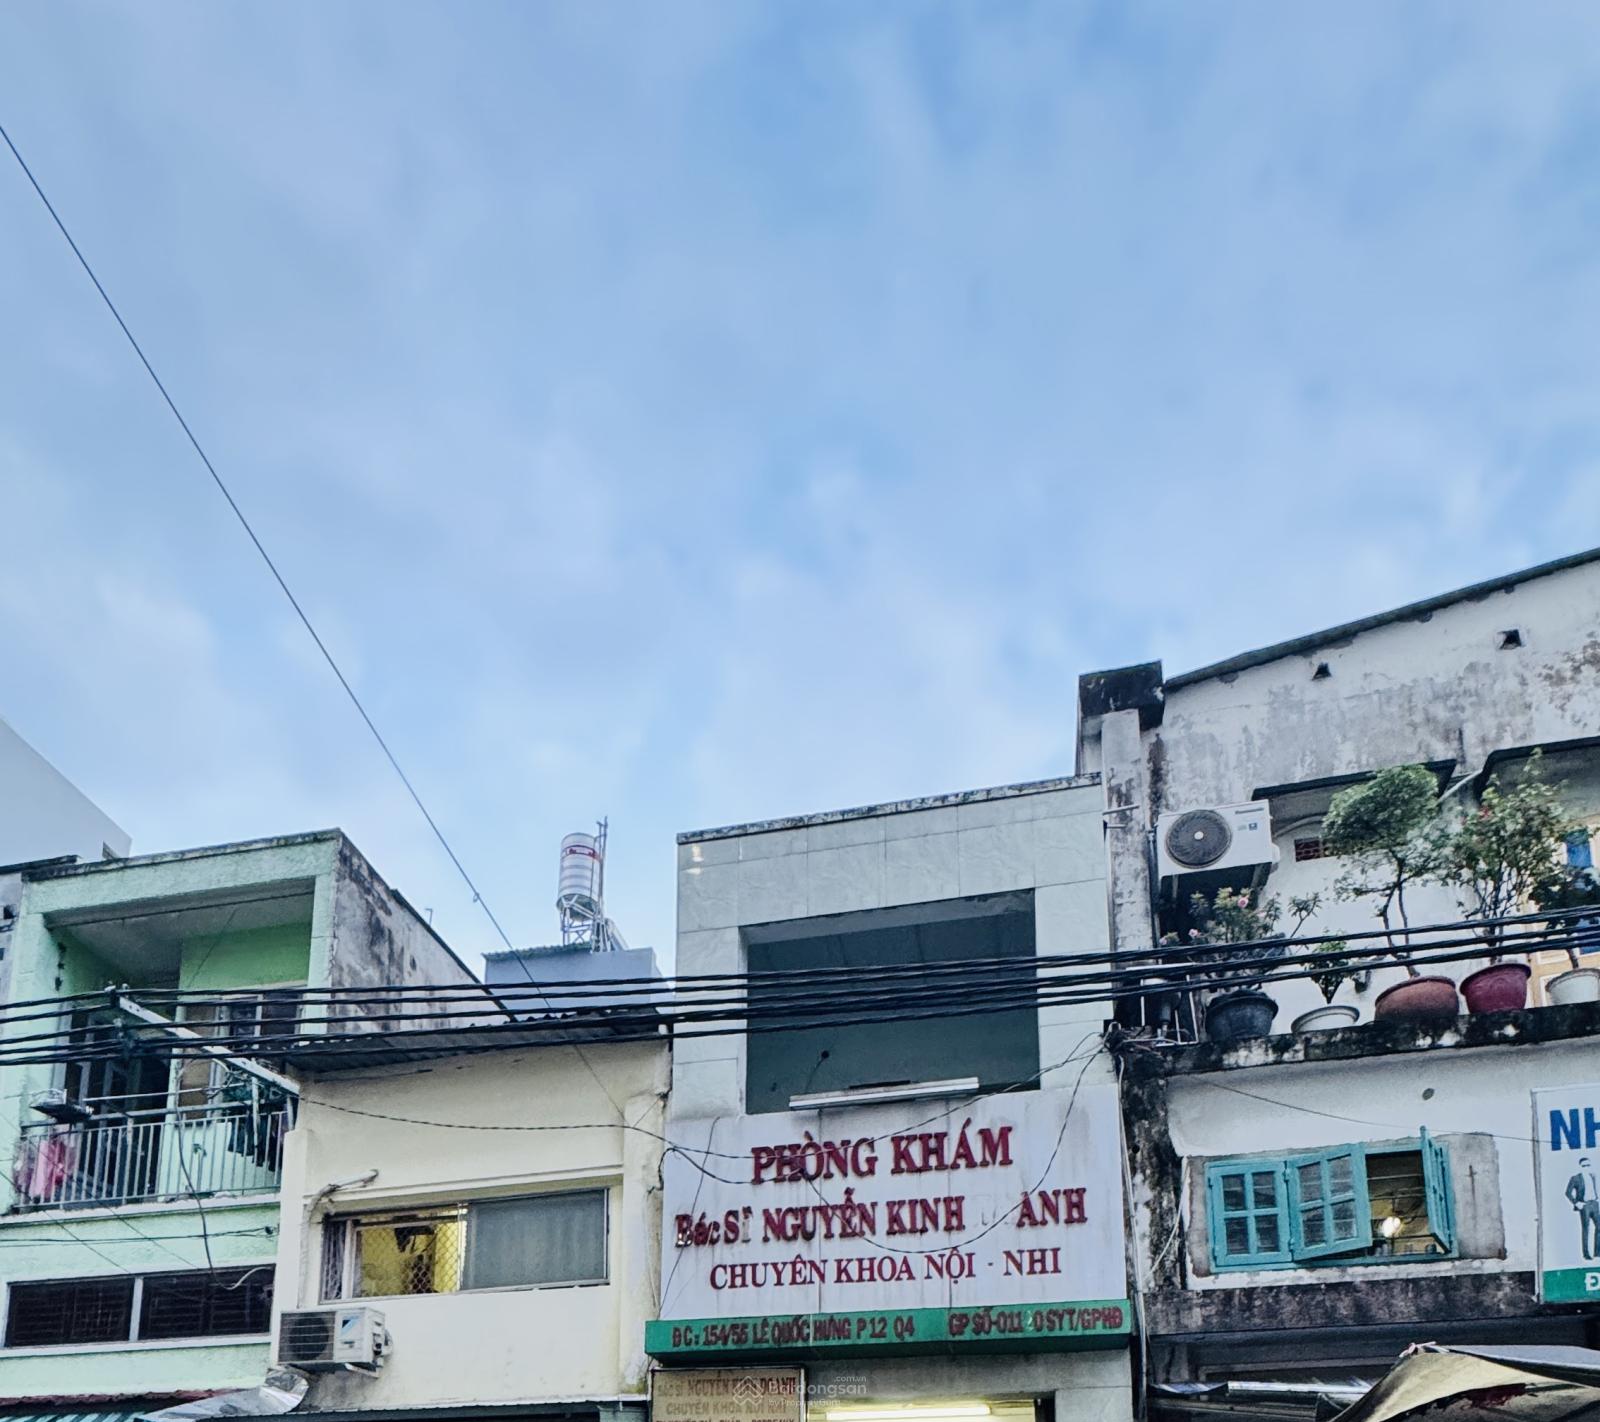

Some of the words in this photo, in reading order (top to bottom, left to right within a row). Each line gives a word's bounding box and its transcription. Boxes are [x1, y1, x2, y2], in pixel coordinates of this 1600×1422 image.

[751, 1130, 878, 1185] PHÒNG
[890, 1117, 1013, 1175] KHÁM
[762, 1187, 878, 1242] NGUYỄN
[886, 1196, 966, 1236] KINH
[710, 1254, 828, 1290] CHUYÊN
[834, 1255, 915, 1284] KHOA
[924, 1247, 976, 1284] NỘI
[1003, 1247, 1061, 1277] NHI
